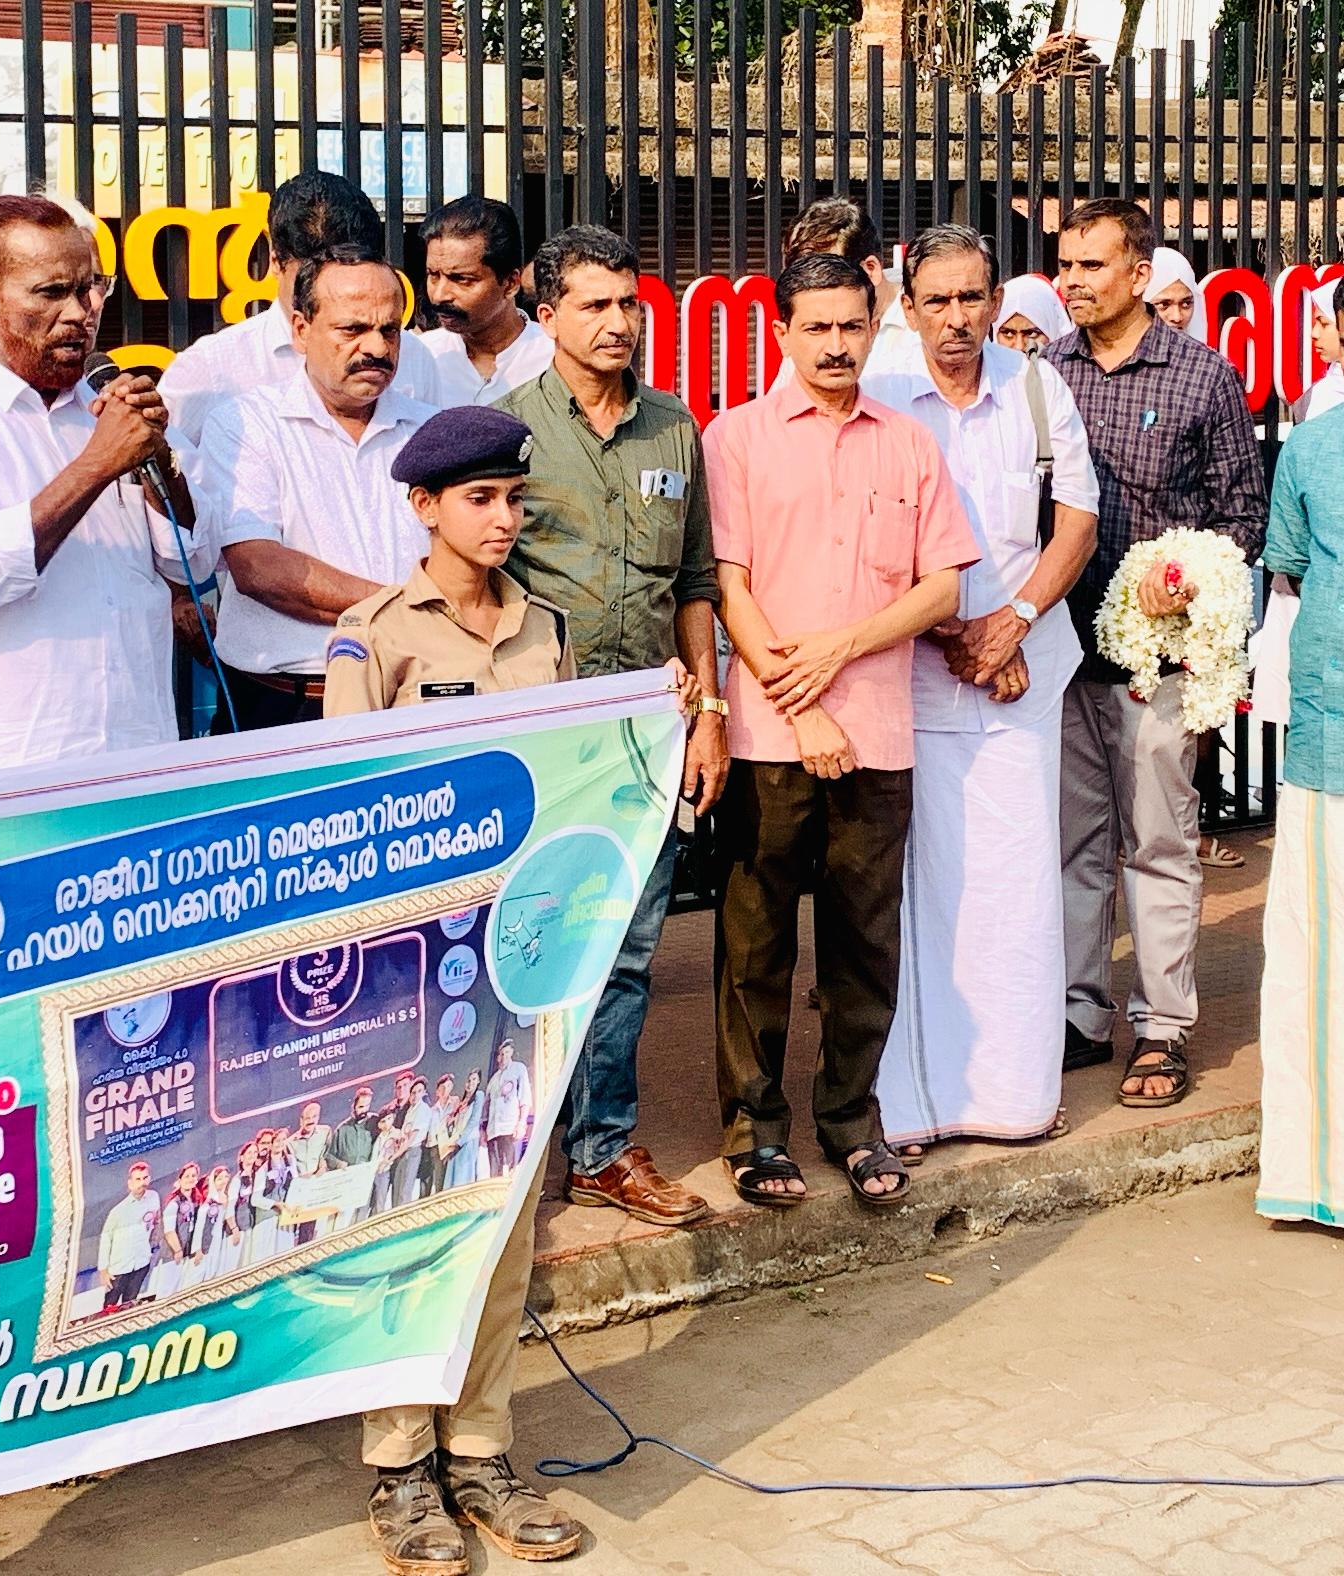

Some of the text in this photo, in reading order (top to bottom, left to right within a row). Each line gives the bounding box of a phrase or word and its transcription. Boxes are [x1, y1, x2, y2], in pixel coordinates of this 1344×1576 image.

[55, 781, 456, 914] രാജീവ് ഗാന്ധി മെമ്മോറിയൽ
[6, 911, 105, 971] ഹയർ
[275, 841, 378, 902] സ്കൂൾ
[386, 808, 503, 873] മൊകേരി
[307, 964, 334, 979] PRIZE
[305, 1003, 337, 1017] SECTION
[313, 994, 330, 1007] HS
[219, 1006, 418, 1073] RAJEEV GANDHI MEMORIAL H S S
[298, 1043, 347, 1067] MOKERI
[301, 1060, 345, 1081] Kannur
[84, 1061, 195, 1113] GRAND
[85, 1085, 195, 1141] FINALE
[115, 1131, 163, 1152] CONVENTION
[164, 1120, 193, 1136] CENTRE
